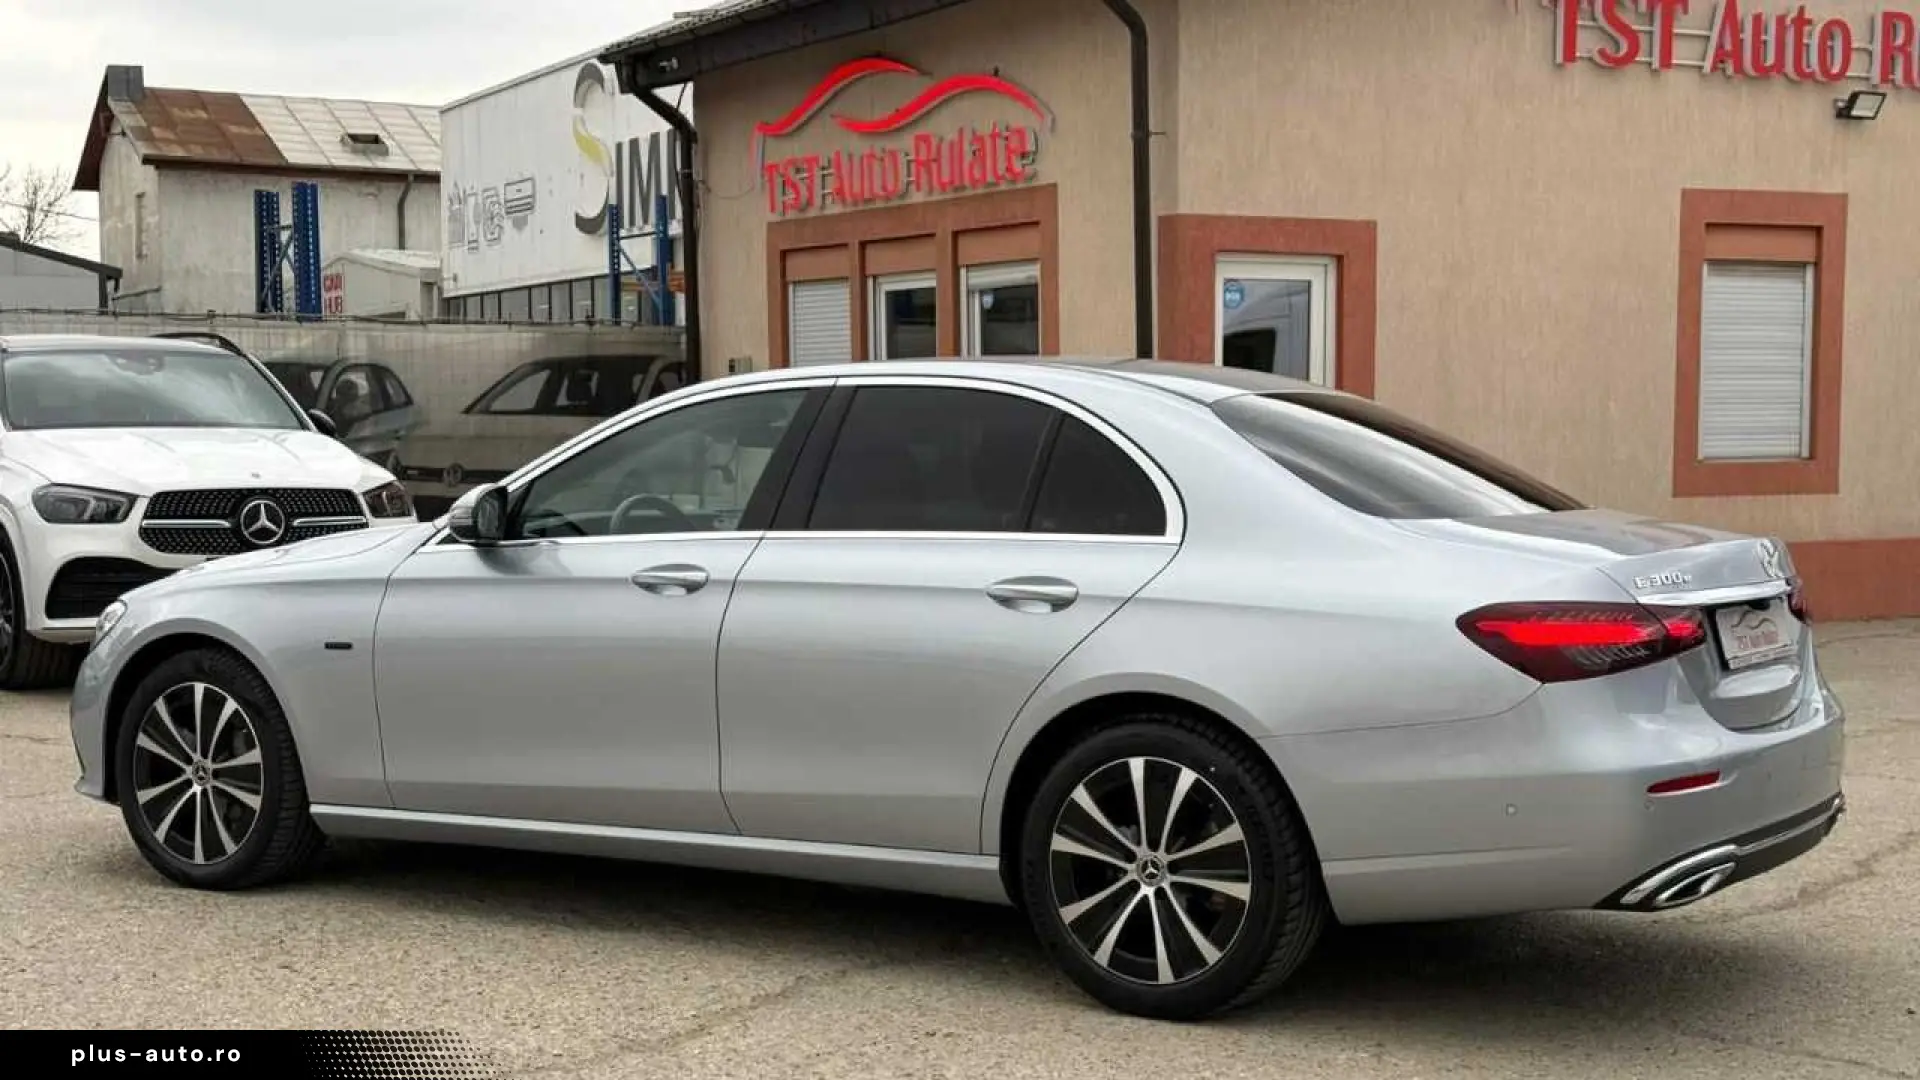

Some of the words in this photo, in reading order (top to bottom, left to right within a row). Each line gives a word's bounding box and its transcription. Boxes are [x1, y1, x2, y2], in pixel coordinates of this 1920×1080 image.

[1706, 0, 1852, 83] Auto
[1873, 11, 1920, 90] R
[764, 154, 822, 216] TST
[831, 144, 900, 204] Auto
[912, 121, 1029, 192] Rulate
